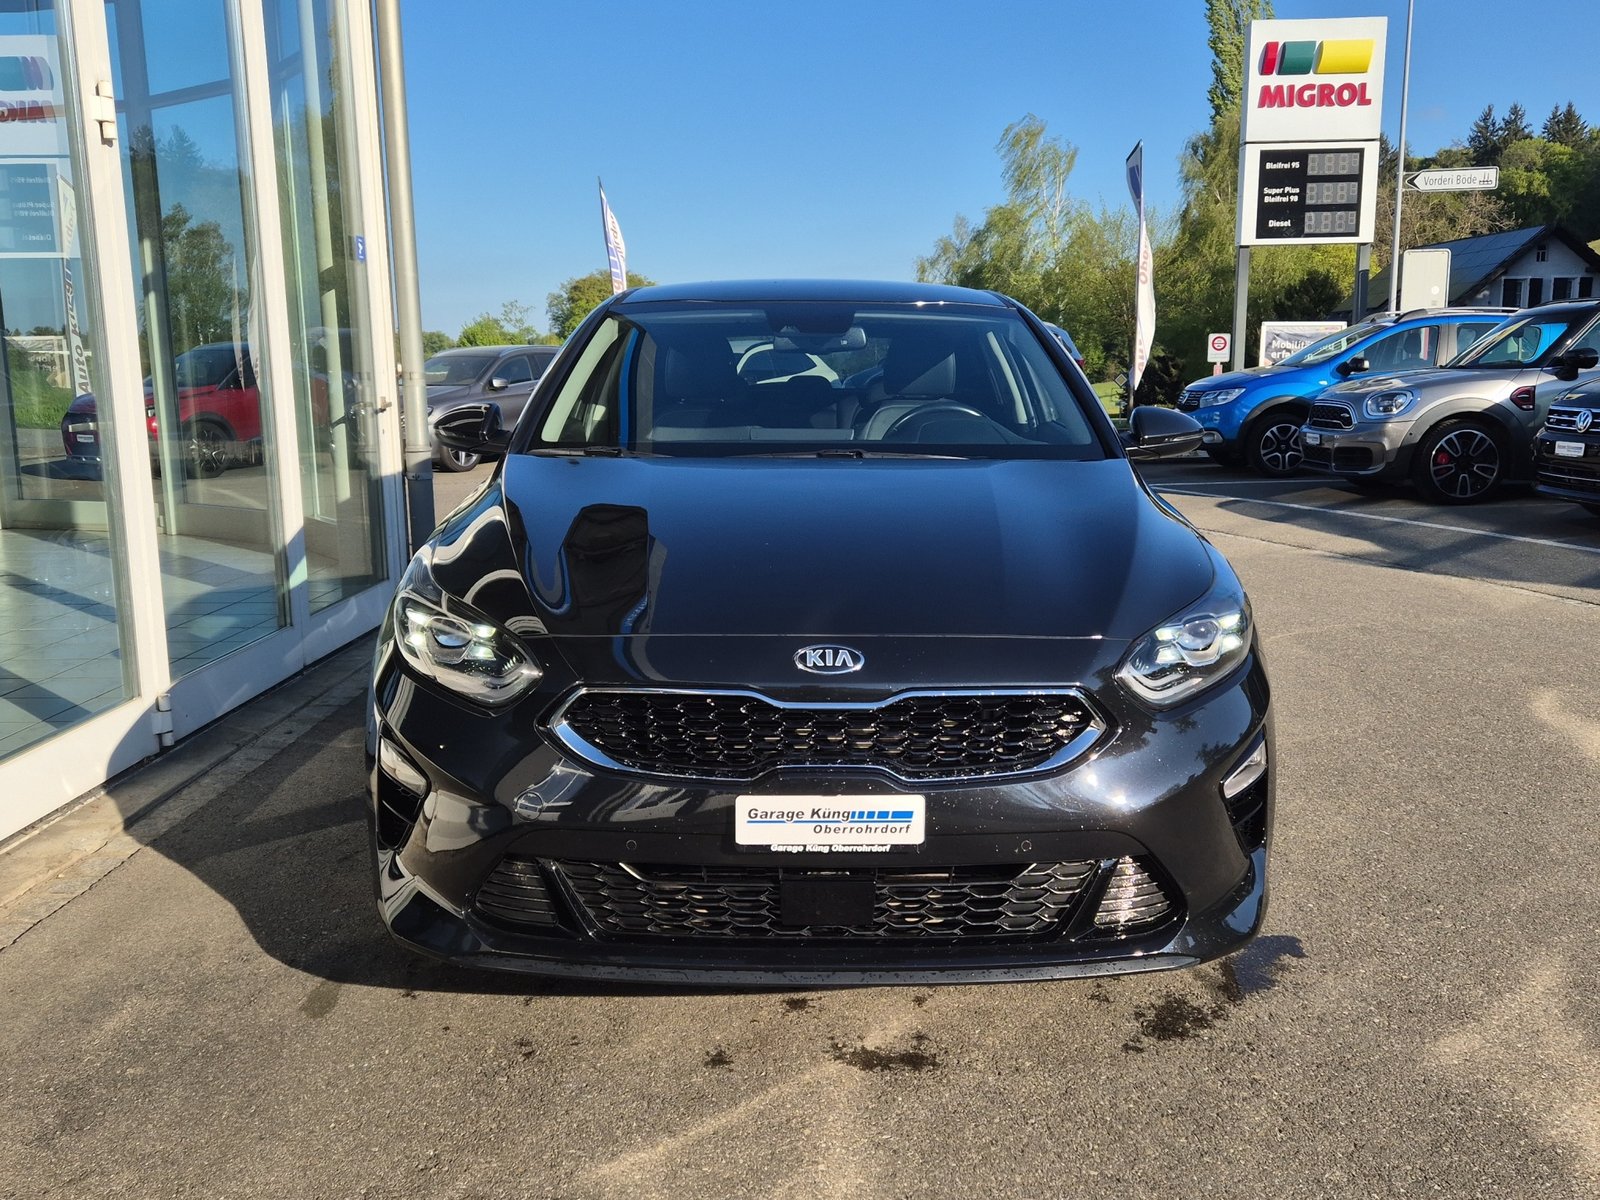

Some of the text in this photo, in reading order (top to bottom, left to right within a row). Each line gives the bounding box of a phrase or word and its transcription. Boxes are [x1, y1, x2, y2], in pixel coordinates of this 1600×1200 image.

[1257, 82, 1372, 108] MIGROL
[1265, 161, 1300, 170] Bleifrei 95
[1423, 175, 1453, 186] Vorderi
[1263, 186, 1300, 195] Super Plus
[1264, 195, 1289, 203] Bleifrei
[1268, 219, 1291, 227] Diesel
[75, 344, 89, 393] Auto
[806, 649, 854, 667] KIA
[747, 808, 851, 822] Garage Küng
[813, 824, 912, 834] Oberrohrdorf
[770, 844, 891, 853] Garage Küng Oberrohrdorf
